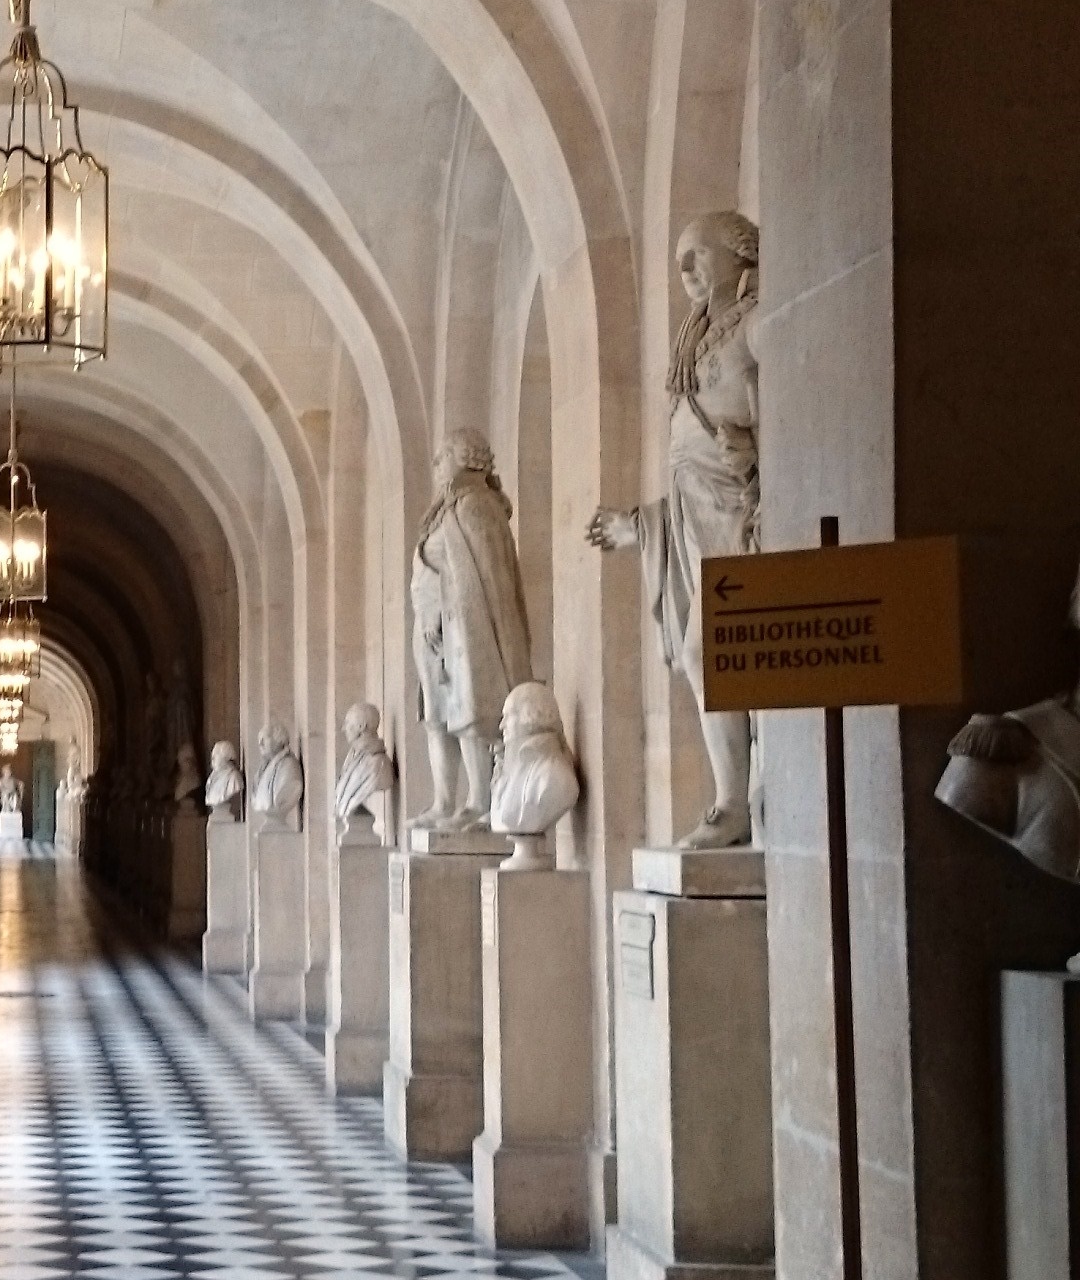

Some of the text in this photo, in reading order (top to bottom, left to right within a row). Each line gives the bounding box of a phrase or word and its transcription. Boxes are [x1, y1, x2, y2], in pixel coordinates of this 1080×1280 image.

[715, 616, 874, 644] BIBLIOTHÈQUE
[716, 646, 884, 672] DU PERSONNEL
